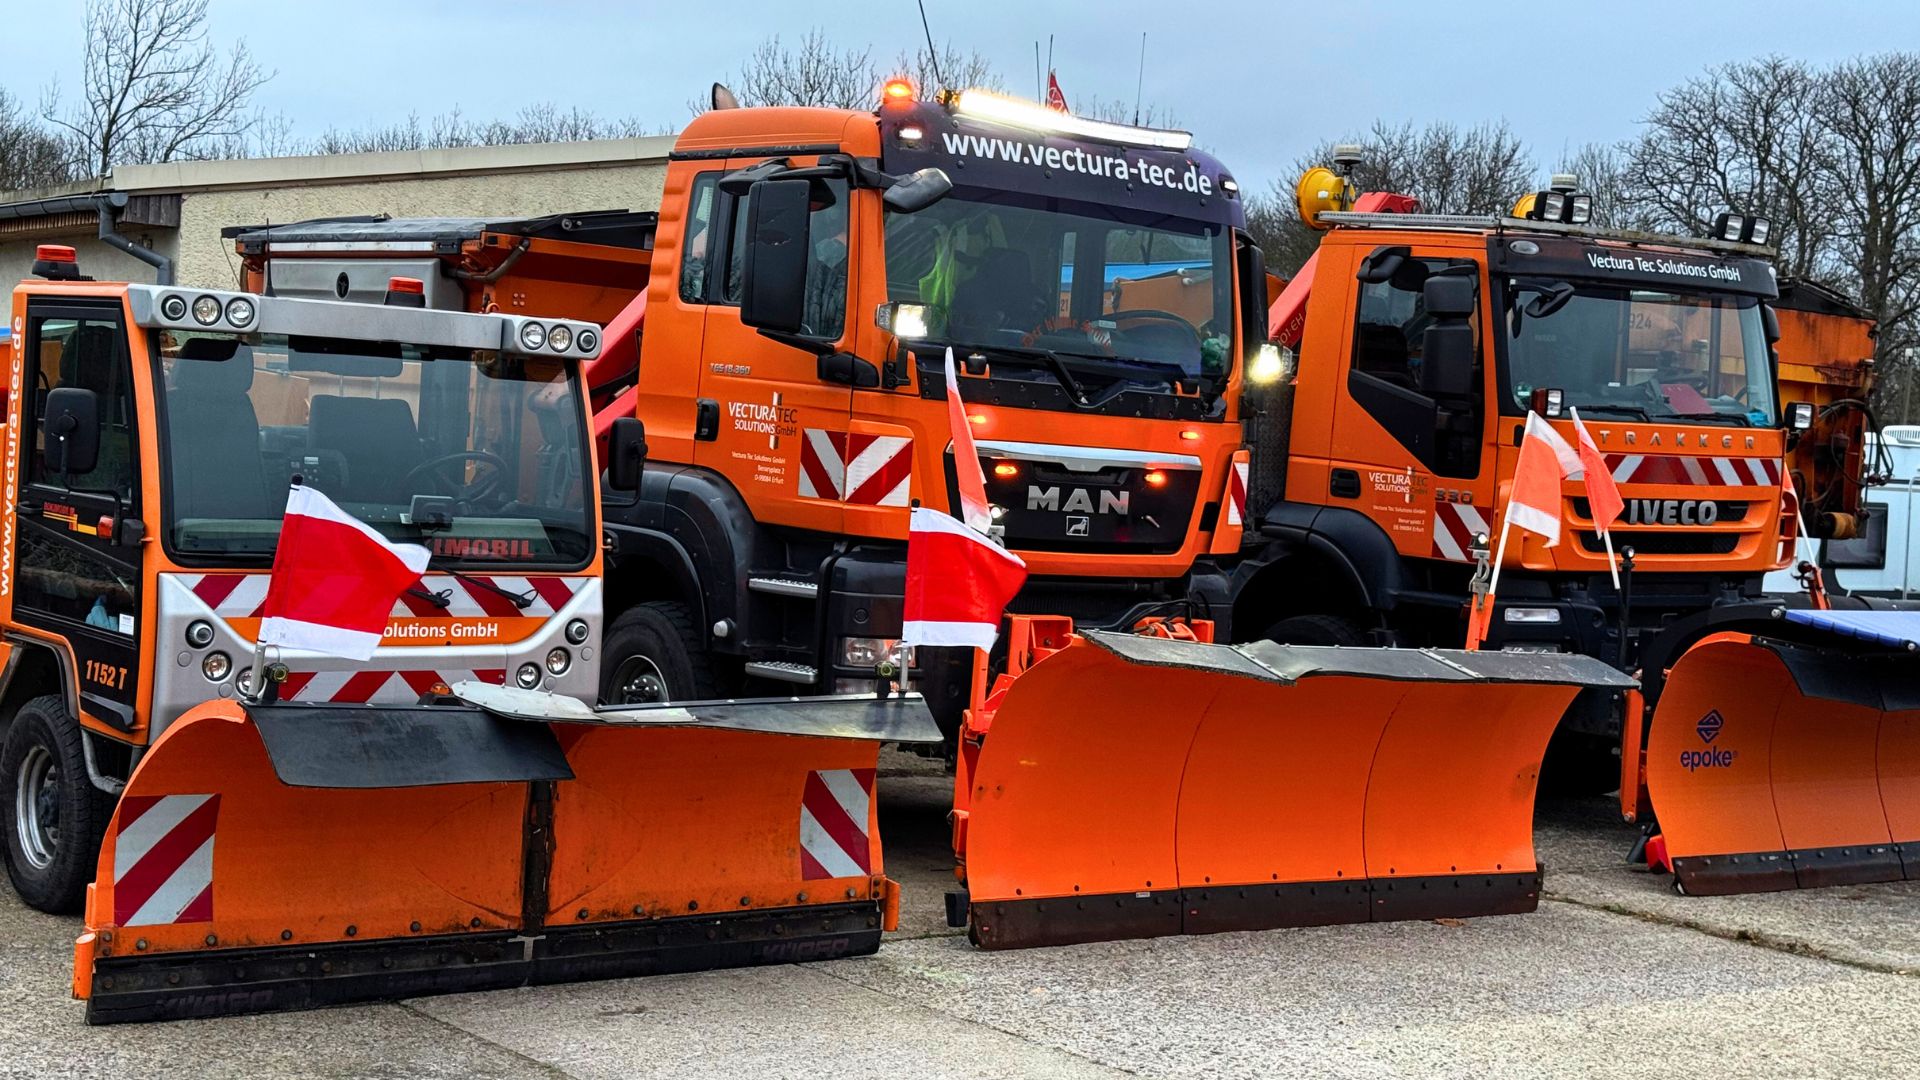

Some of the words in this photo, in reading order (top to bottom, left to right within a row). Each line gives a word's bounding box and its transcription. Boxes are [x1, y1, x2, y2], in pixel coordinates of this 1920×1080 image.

[941, 132, 1212, 196] www.vectura-tec.de
[1587, 252, 1634, 270] Vectura
[1635, 256, 1656, 273] Tec
[1656, 259, 1708, 278] Solutions
[1708, 264, 1741, 282] GmbH
[728, 401, 777, 422] VECTURA
[734, 419, 776, 435] SOLUTIONS
[1599, 430, 1755, 449] TRAKKER
[1, 315, 22, 597] www.vectura-tec.de
[1368, 471, 1411, 486] VECTURA
[1374, 483, 1410, 494] SOLUTIONS
[1027, 485, 1130, 515] MAN
[1629, 499, 1718, 525] IVECO
[383, 622, 447, 638] olutions
[450, 622, 498, 638] GmbH
[85, 659, 116, 688] 1152
[118, 667, 128, 690] T
[1680, 745, 1733, 773] epoke
